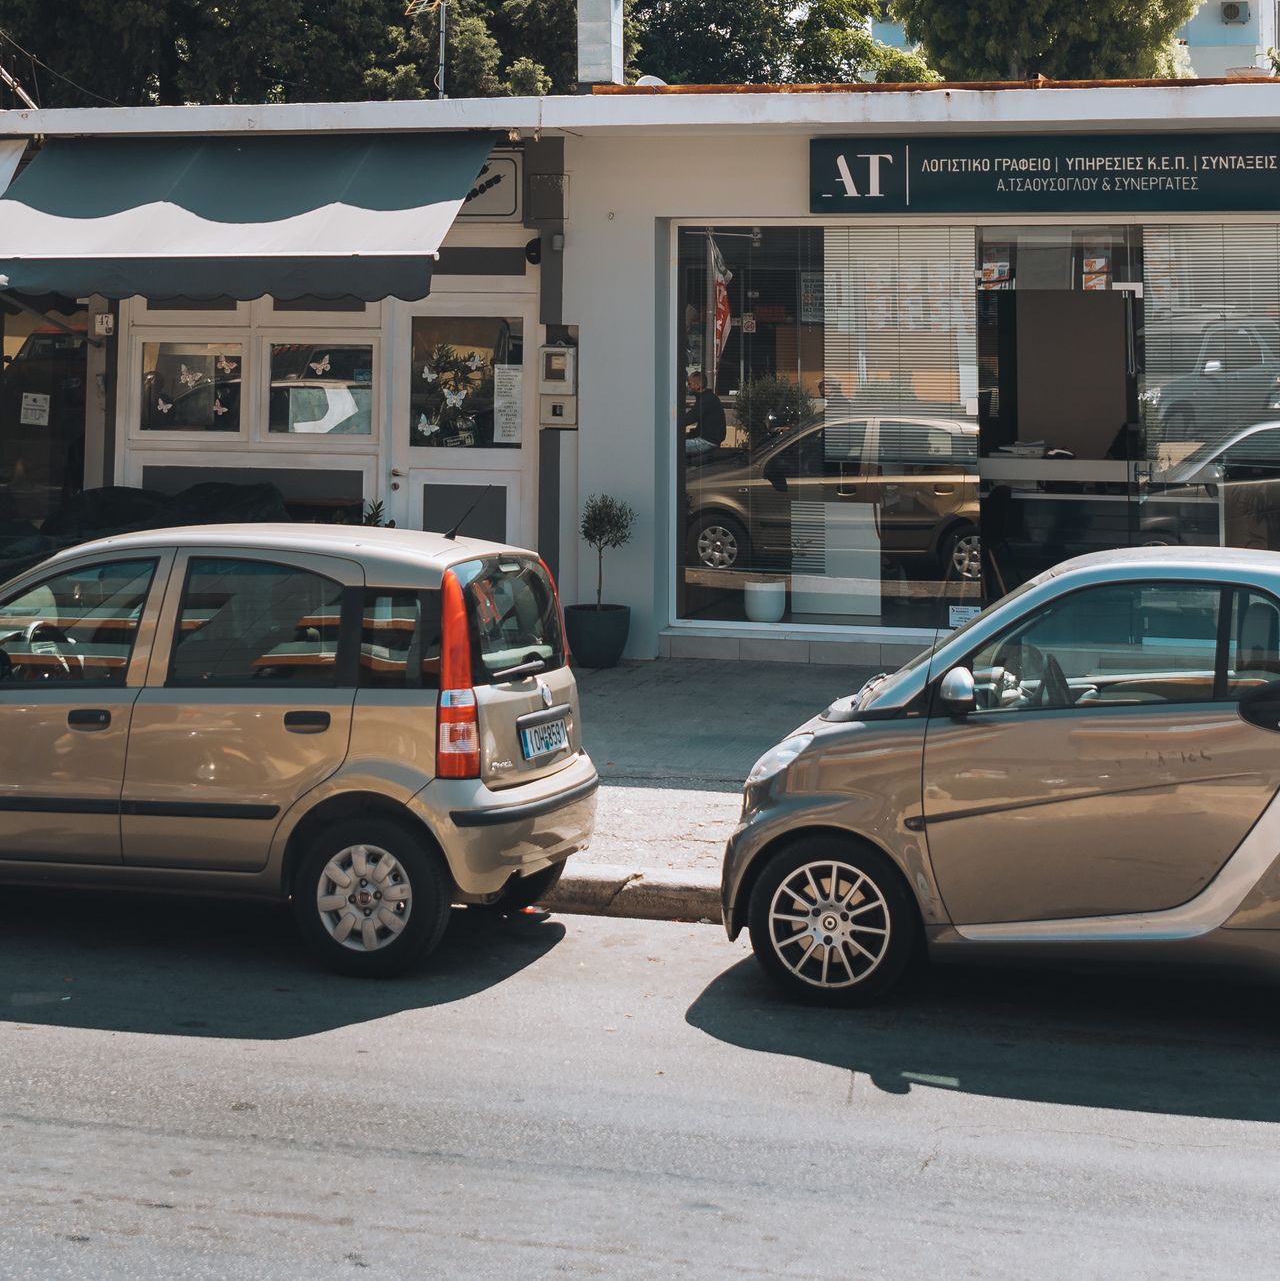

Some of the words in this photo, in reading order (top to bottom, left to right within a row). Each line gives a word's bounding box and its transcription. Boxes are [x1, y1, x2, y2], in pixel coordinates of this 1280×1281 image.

[921, 158, 990, 173] ΛΟΓΙΣΤΙΚΟ
[994, 158, 1051, 172] ΓΡΑΦΕΙΟ
[1065, 156, 1144, 171] ΥΠΗΡΕΣΙΕΣ
[1147, 156, 1190, 170] Κ.Ε.Π.
[1201, 155, 1278, 170] ΣΥΝΤΑΞΕΙΣ
[996, 177, 1098, 192] Α.ΤΣΑΟΥΣΟΓΛΟΥ
[1102, 177, 1111, 191] &
[1114, 176, 1199, 191] ΣΥΝΕΡΓΑΤΕΣ
[99, 314, 110, 326] 47
